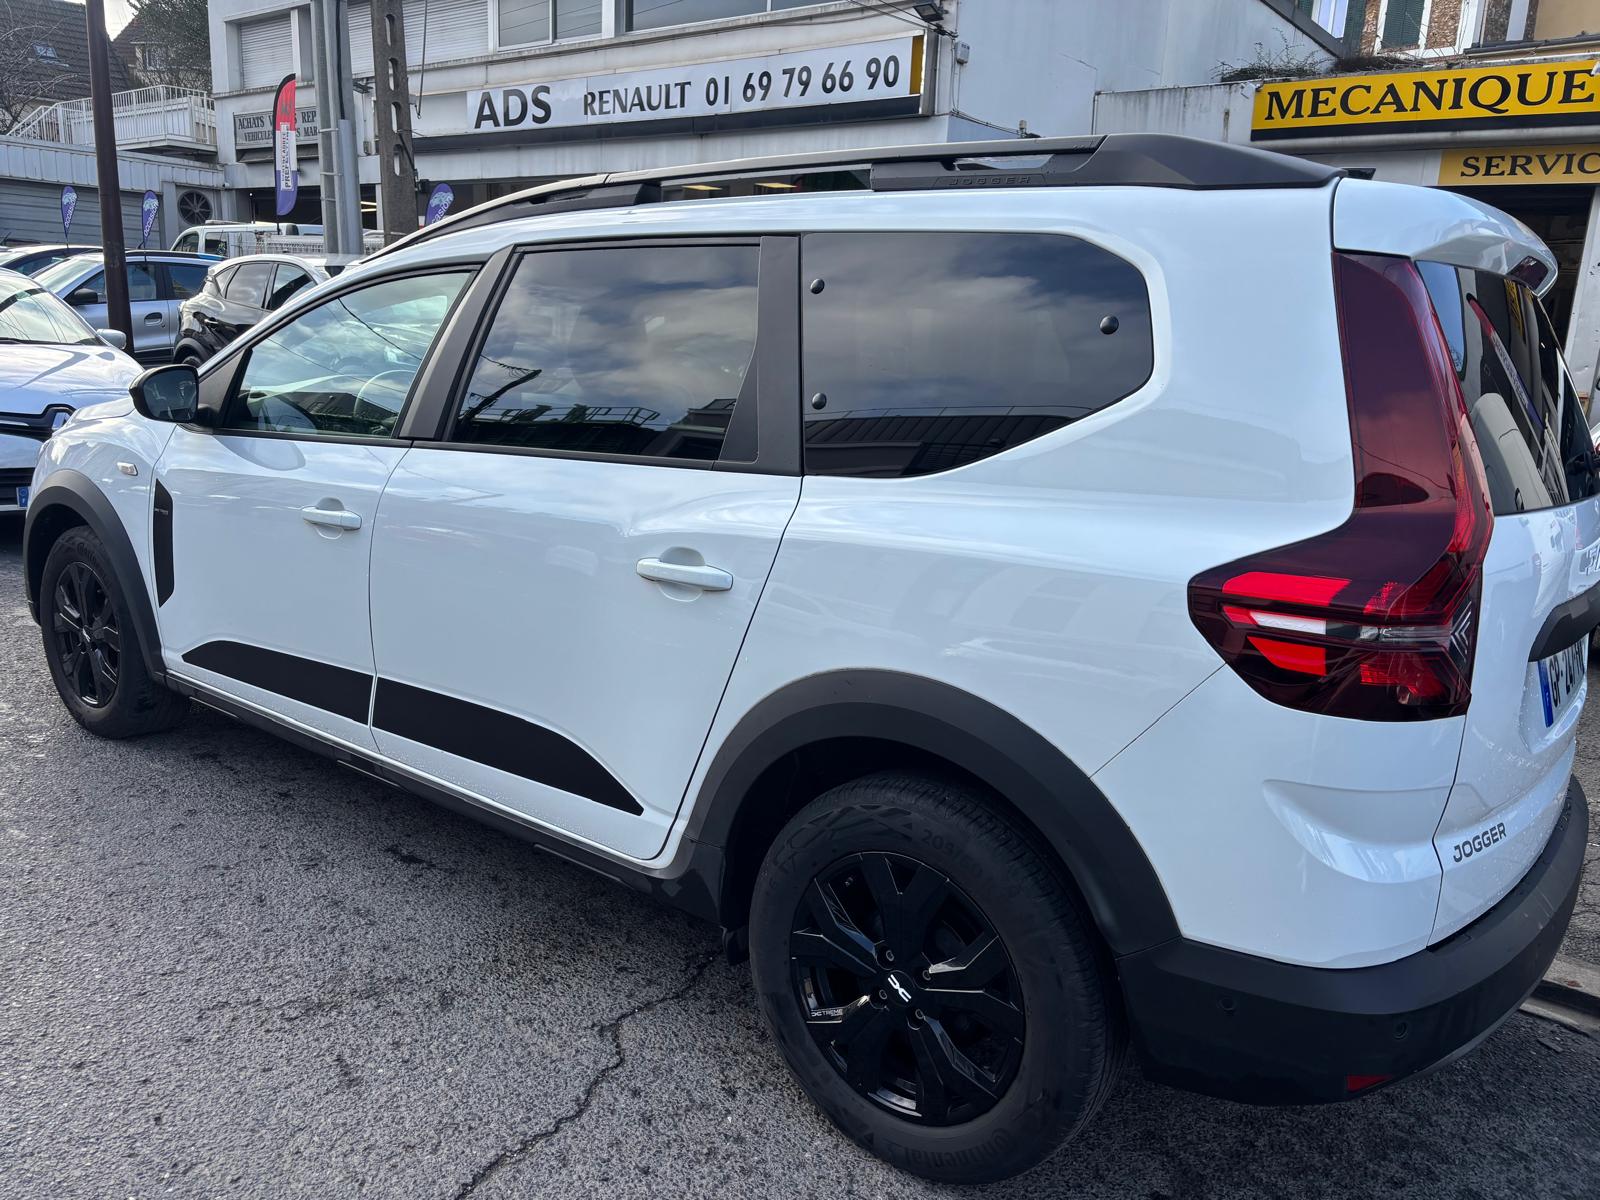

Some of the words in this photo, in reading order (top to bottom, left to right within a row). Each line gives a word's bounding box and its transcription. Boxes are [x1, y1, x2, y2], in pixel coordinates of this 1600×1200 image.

[474, 85, 552, 129] ADS
[583, 81, 691, 116] RENAULT
[705, 76, 730, 107] 01
[742, 70, 772, 103] 69
[782, 65, 812, 98] 79
[822, 60, 854, 94] 66
[865, 55, 900, 90] 90
[1265, 68, 1595, 120] MECANIQUE
[238, 115, 265, 130] ACHATS
[244, 130, 274, 142] VEHICULE
[1460, 152, 1600, 177] SERVIC
[948, 175, 1031, 186] JOGGER
[1453, 822, 1507, 863] JOGGER
